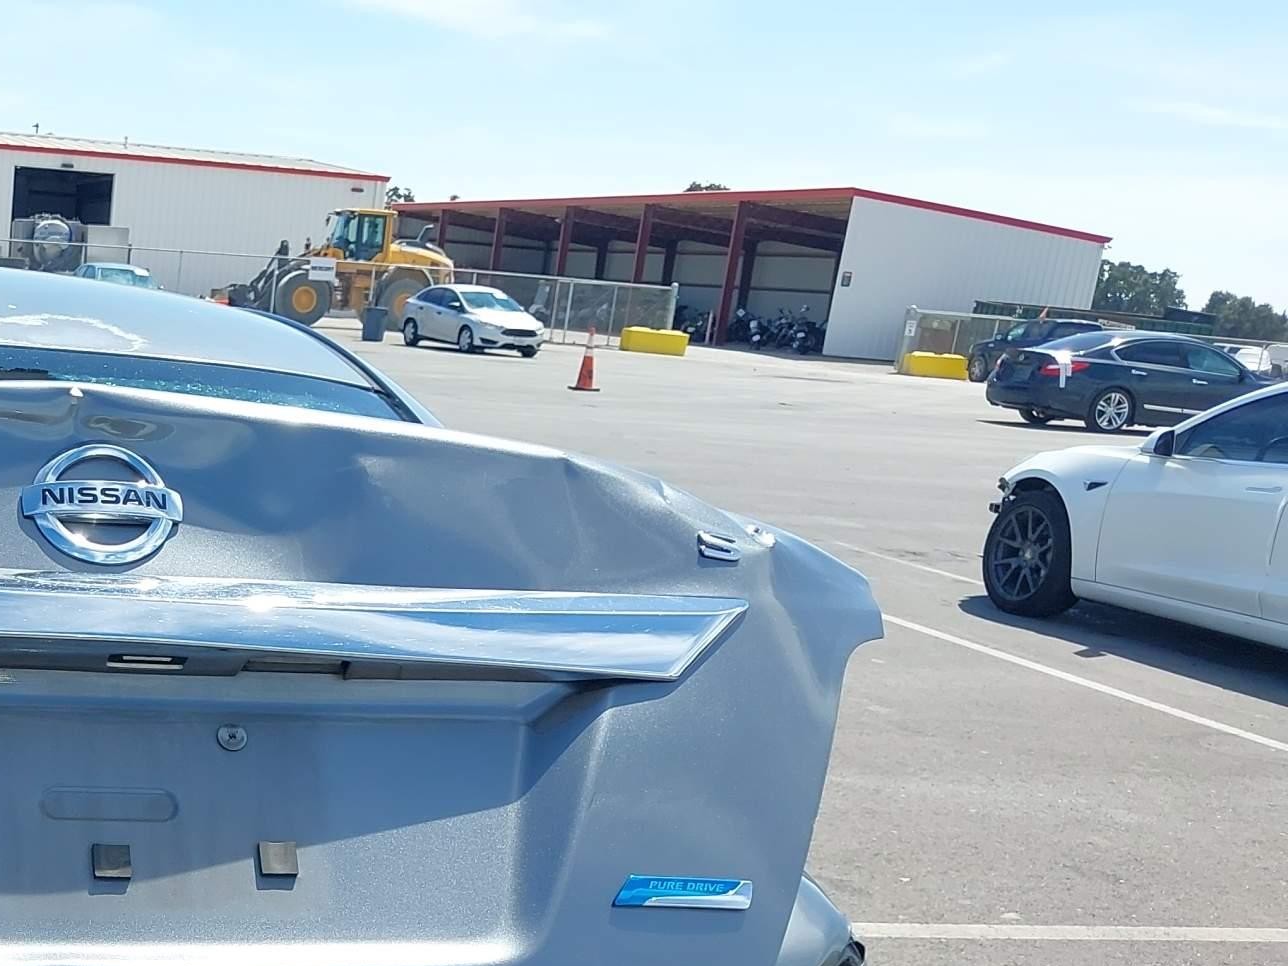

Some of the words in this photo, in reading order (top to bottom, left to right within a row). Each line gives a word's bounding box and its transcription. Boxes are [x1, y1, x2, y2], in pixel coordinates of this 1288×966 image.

[41, 487, 167, 510] NISSAN
[649, 880, 683, 891] PURE
[686, 882, 725, 893] DRIVE
